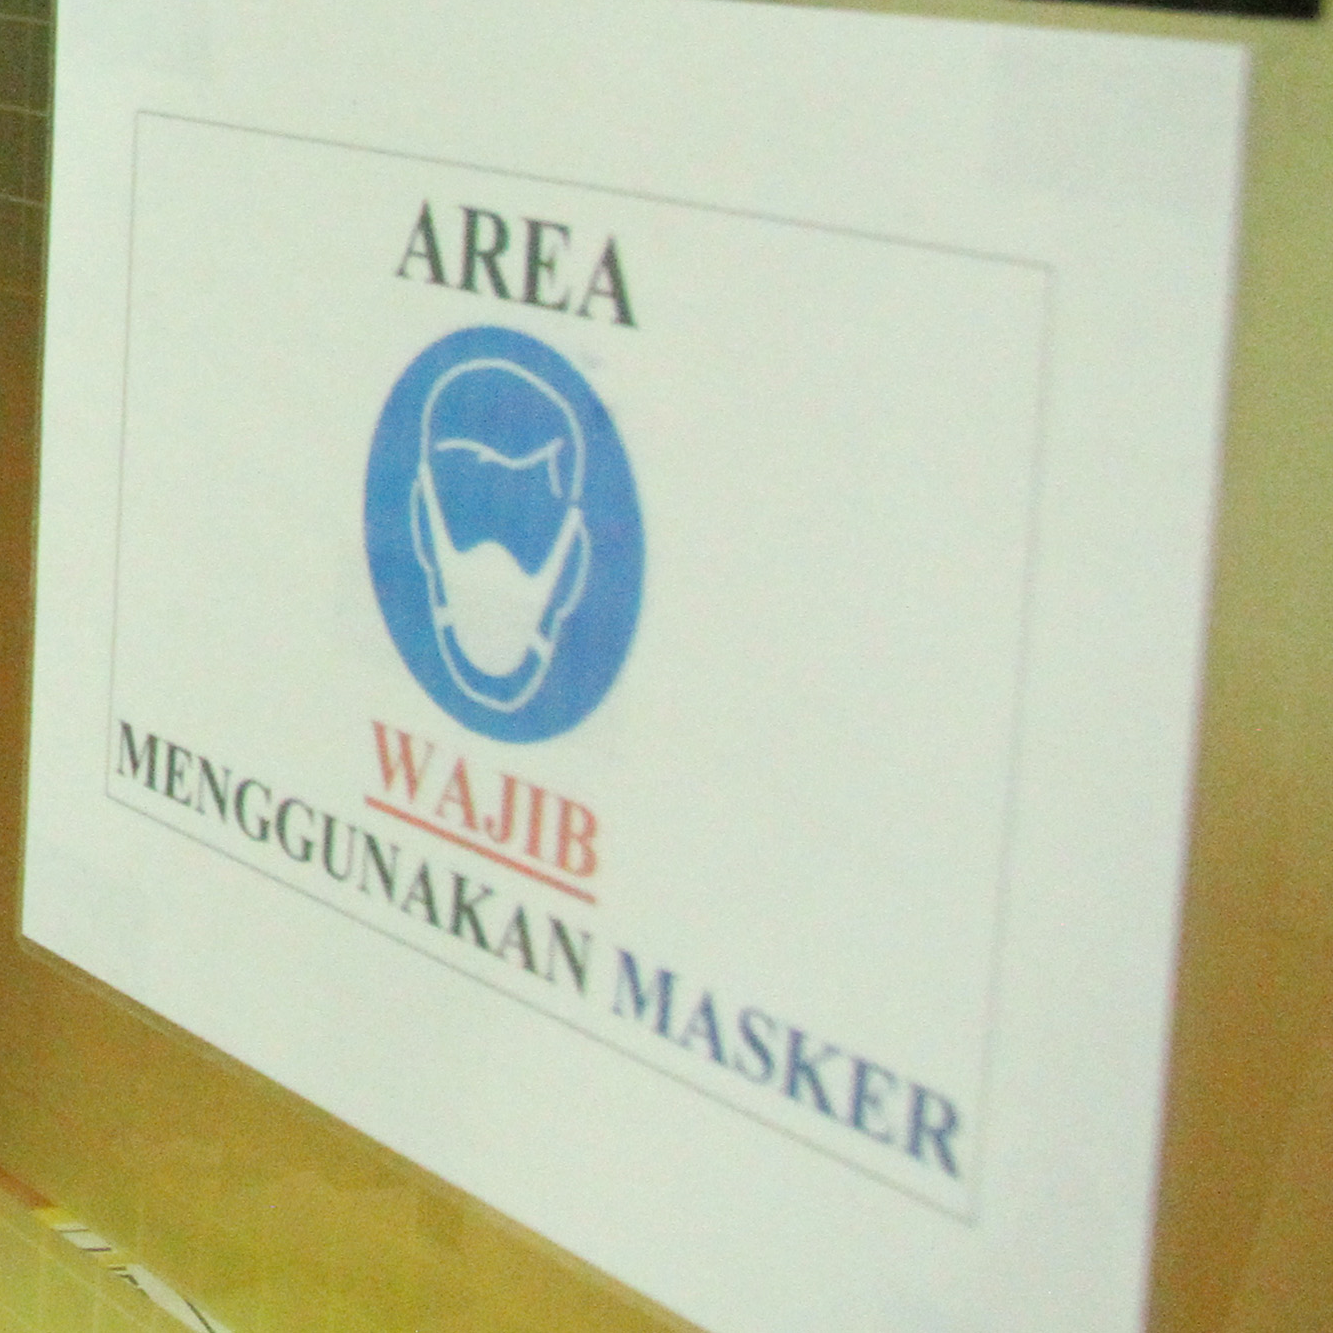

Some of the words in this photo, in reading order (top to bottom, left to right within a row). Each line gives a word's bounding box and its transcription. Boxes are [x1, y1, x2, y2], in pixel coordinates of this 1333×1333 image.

[395, 198, 638, 330] AREA
[364, 720, 601, 903] WAJIB
[115, 720, 594, 998] MENGGUNAKAN
[611, 948, 965, 1179] MASKER
